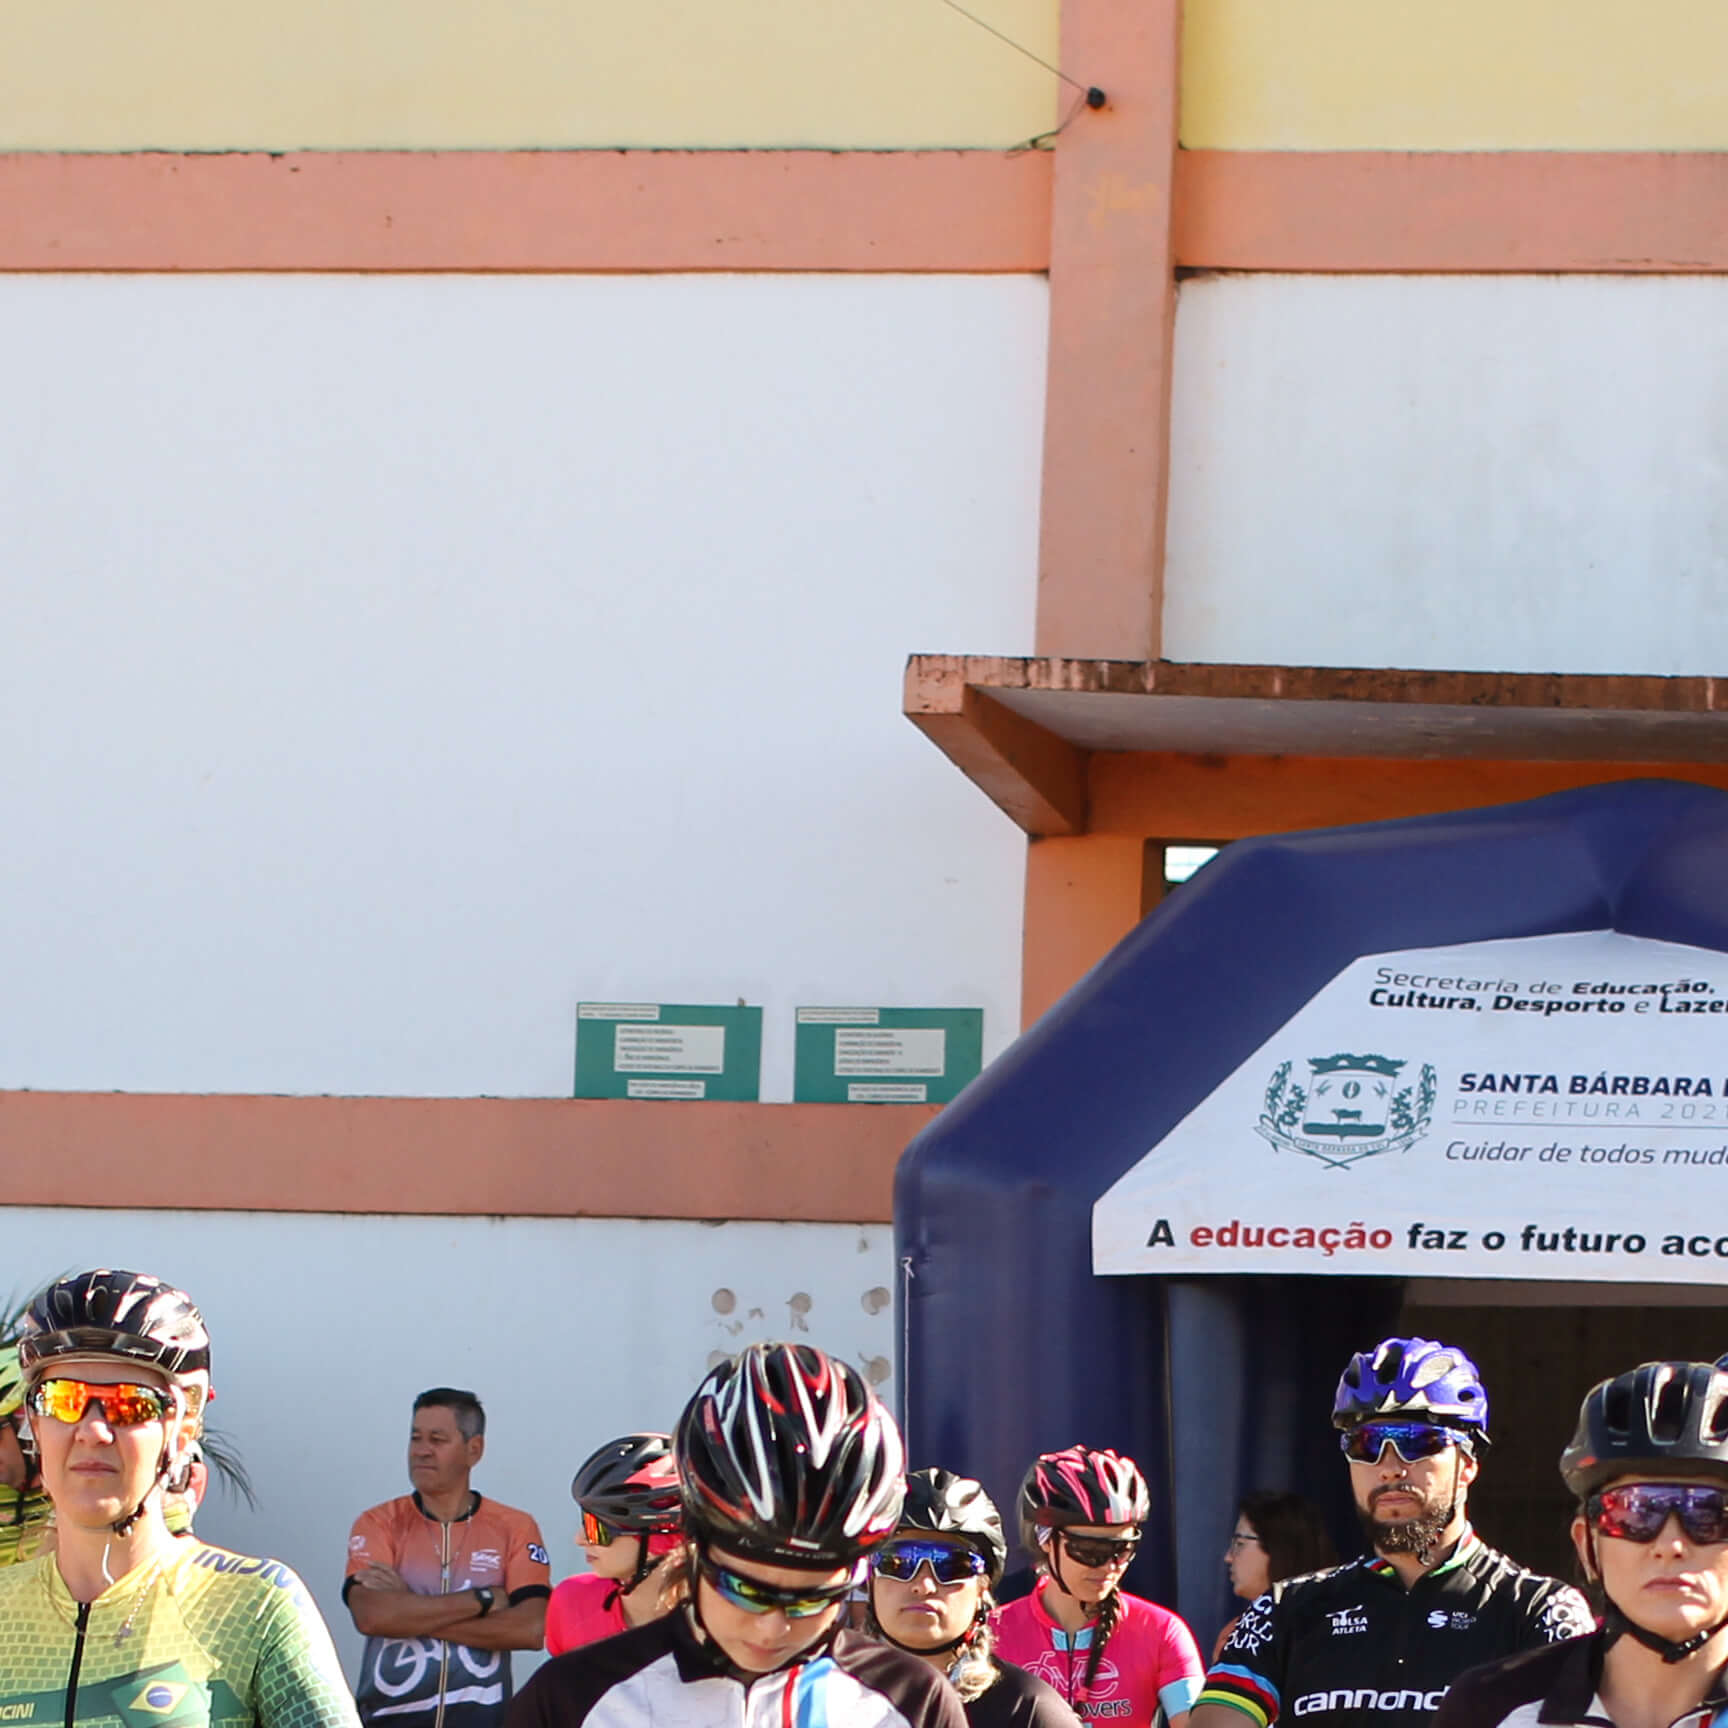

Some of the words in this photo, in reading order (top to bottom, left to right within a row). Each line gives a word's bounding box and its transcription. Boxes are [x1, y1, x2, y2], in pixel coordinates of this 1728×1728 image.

[1375, 967, 1519, 995] Secretaria
[1529, 980, 1562, 995] de
[1572, 979, 1716, 999] Educação,
[1369, 989, 1483, 1012] Cultura,
[1492, 994, 1626, 1017] Desporto
[1634, 999, 1650, 1014] e
[1459, 1073, 1559, 1095] SANTA
[1568, 1071, 1714, 1098] BÁRBARA
[1453, 1099, 1641, 1119] PREFEITURA
[1445, 1140, 1533, 1162] Cuidar
[1538, 1141, 1572, 1164] de
[1579, 1143, 1655, 1165] todos
[1146, 1219, 1176, 1248] A
[1189, 1219, 1393, 1258] educação
[1406, 1221, 1468, 1251] faz
[1481, 1231, 1506, 1252] o
[1519, 1224, 1647, 1256] futuro
[1332, 1616, 1369, 1628] BOLSA
[1332, 1625, 1368, 1636] ATLETA
[1080, 1699, 1133, 1719] overs
